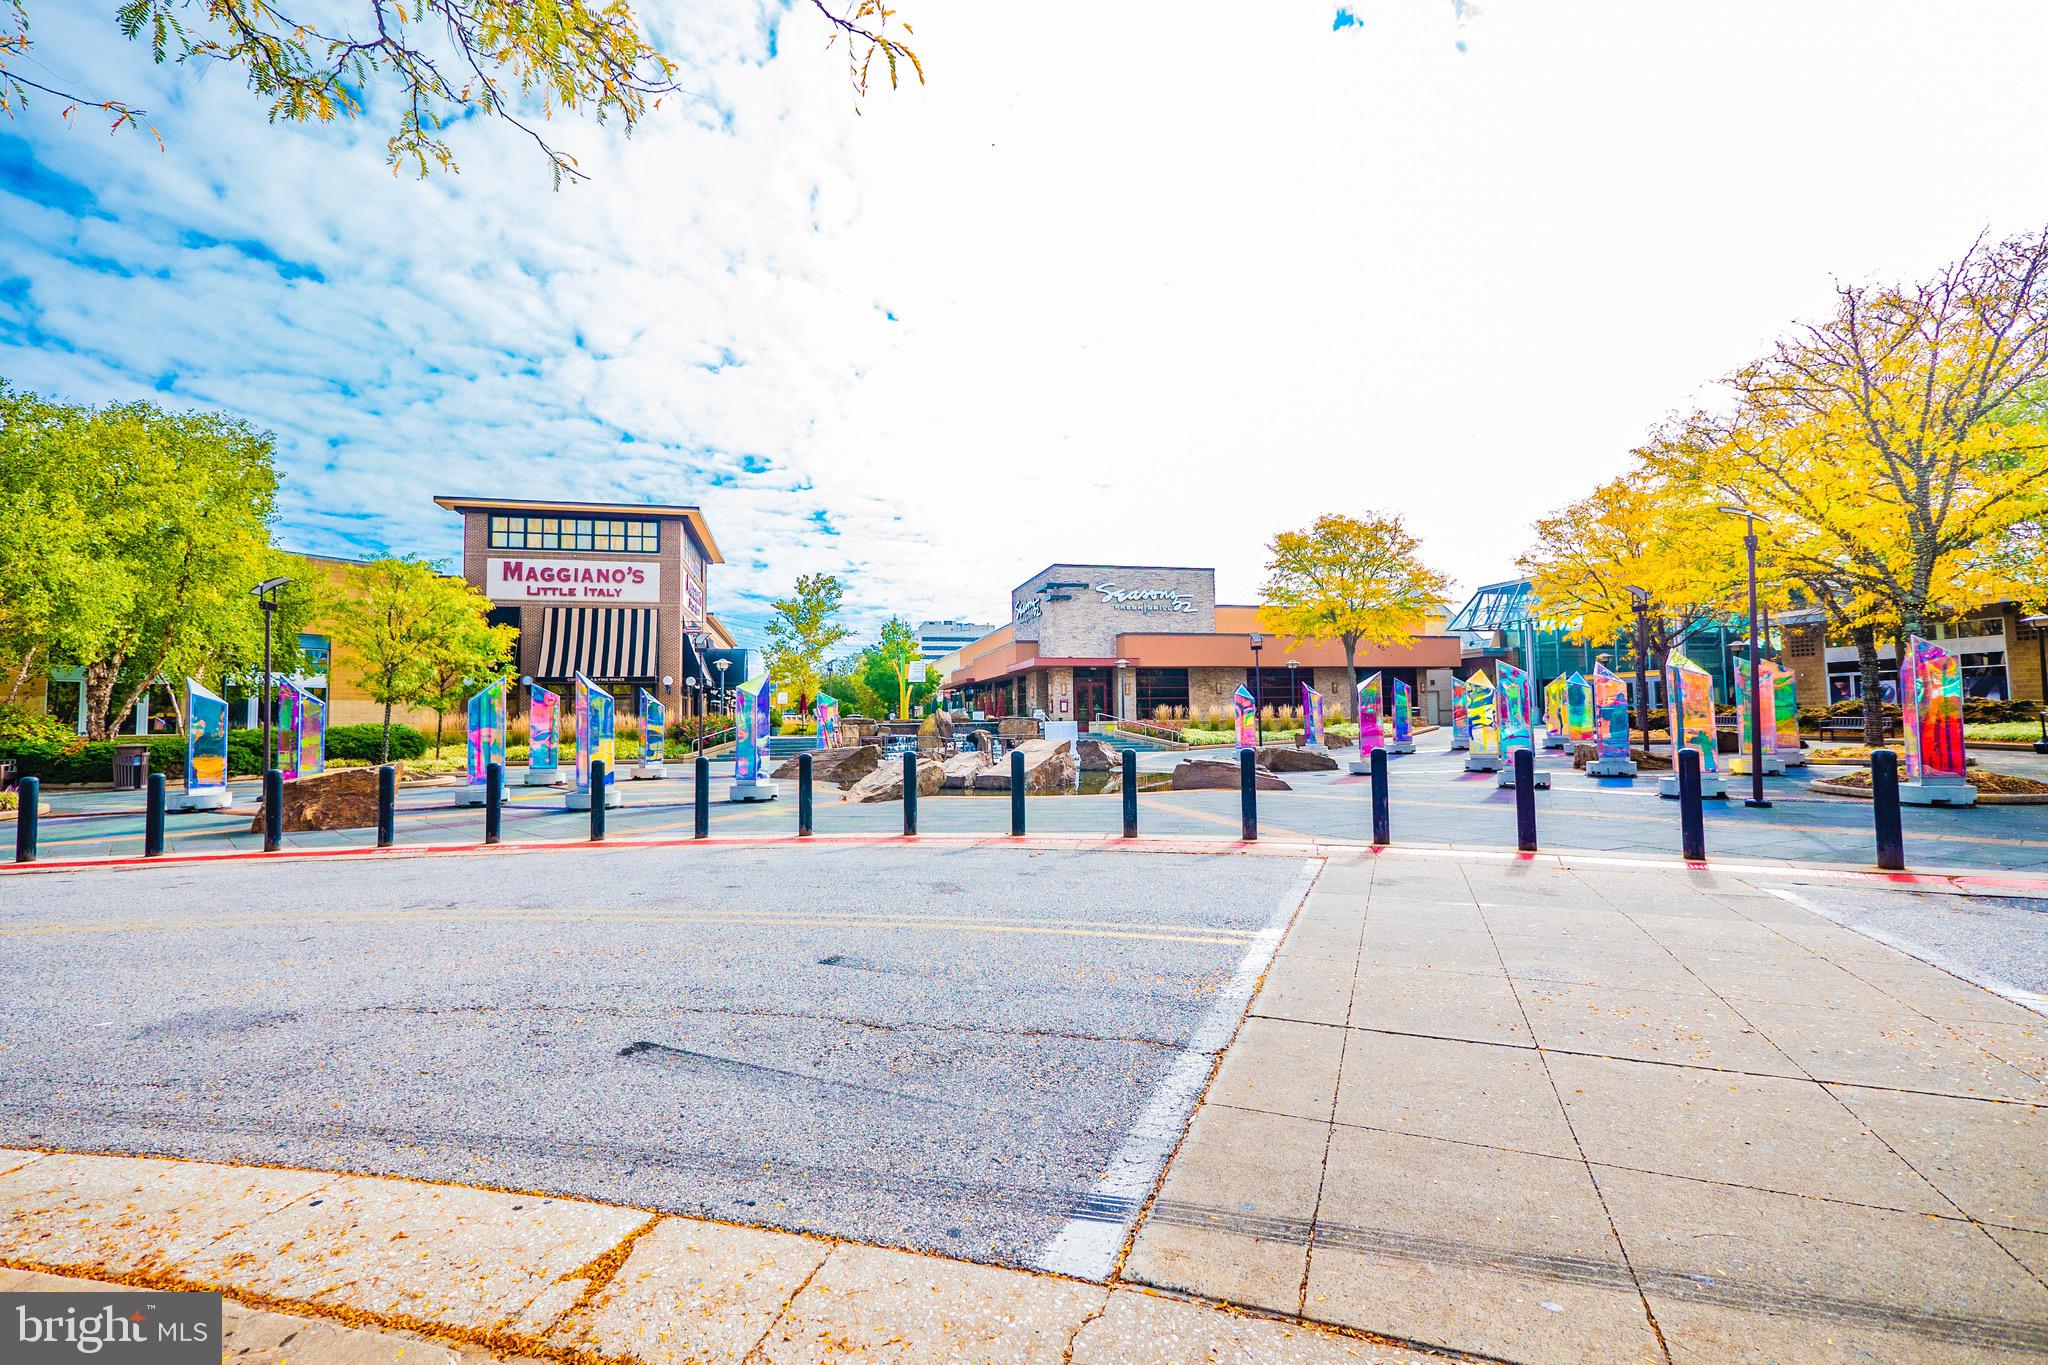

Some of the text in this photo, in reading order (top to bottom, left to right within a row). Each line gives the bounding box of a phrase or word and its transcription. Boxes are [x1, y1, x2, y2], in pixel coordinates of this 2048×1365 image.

[503, 561, 645, 584] MAGGIANO'S
[526, 585, 623, 598] LITTLE ITALY
[1095, 582, 1177, 603] Seasons
